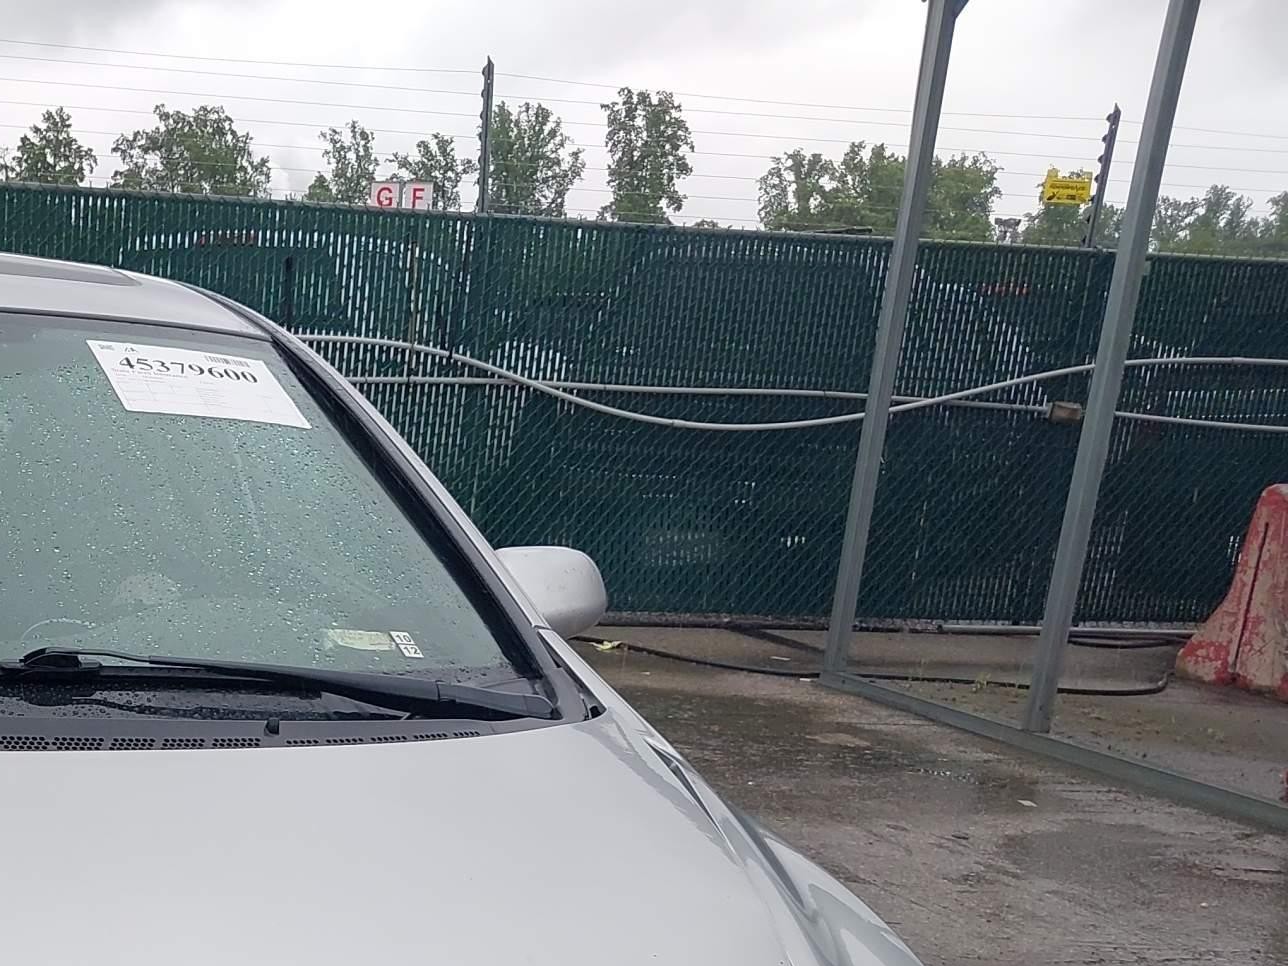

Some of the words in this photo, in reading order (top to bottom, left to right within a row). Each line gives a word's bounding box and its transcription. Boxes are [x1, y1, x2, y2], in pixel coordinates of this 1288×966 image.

[376, 186, 393, 207] G
[412, 187, 425, 208] F
[119, 356, 258, 383] 45379600
[395, 634, 412, 643] 10
[403, 646, 421, 655] 12
